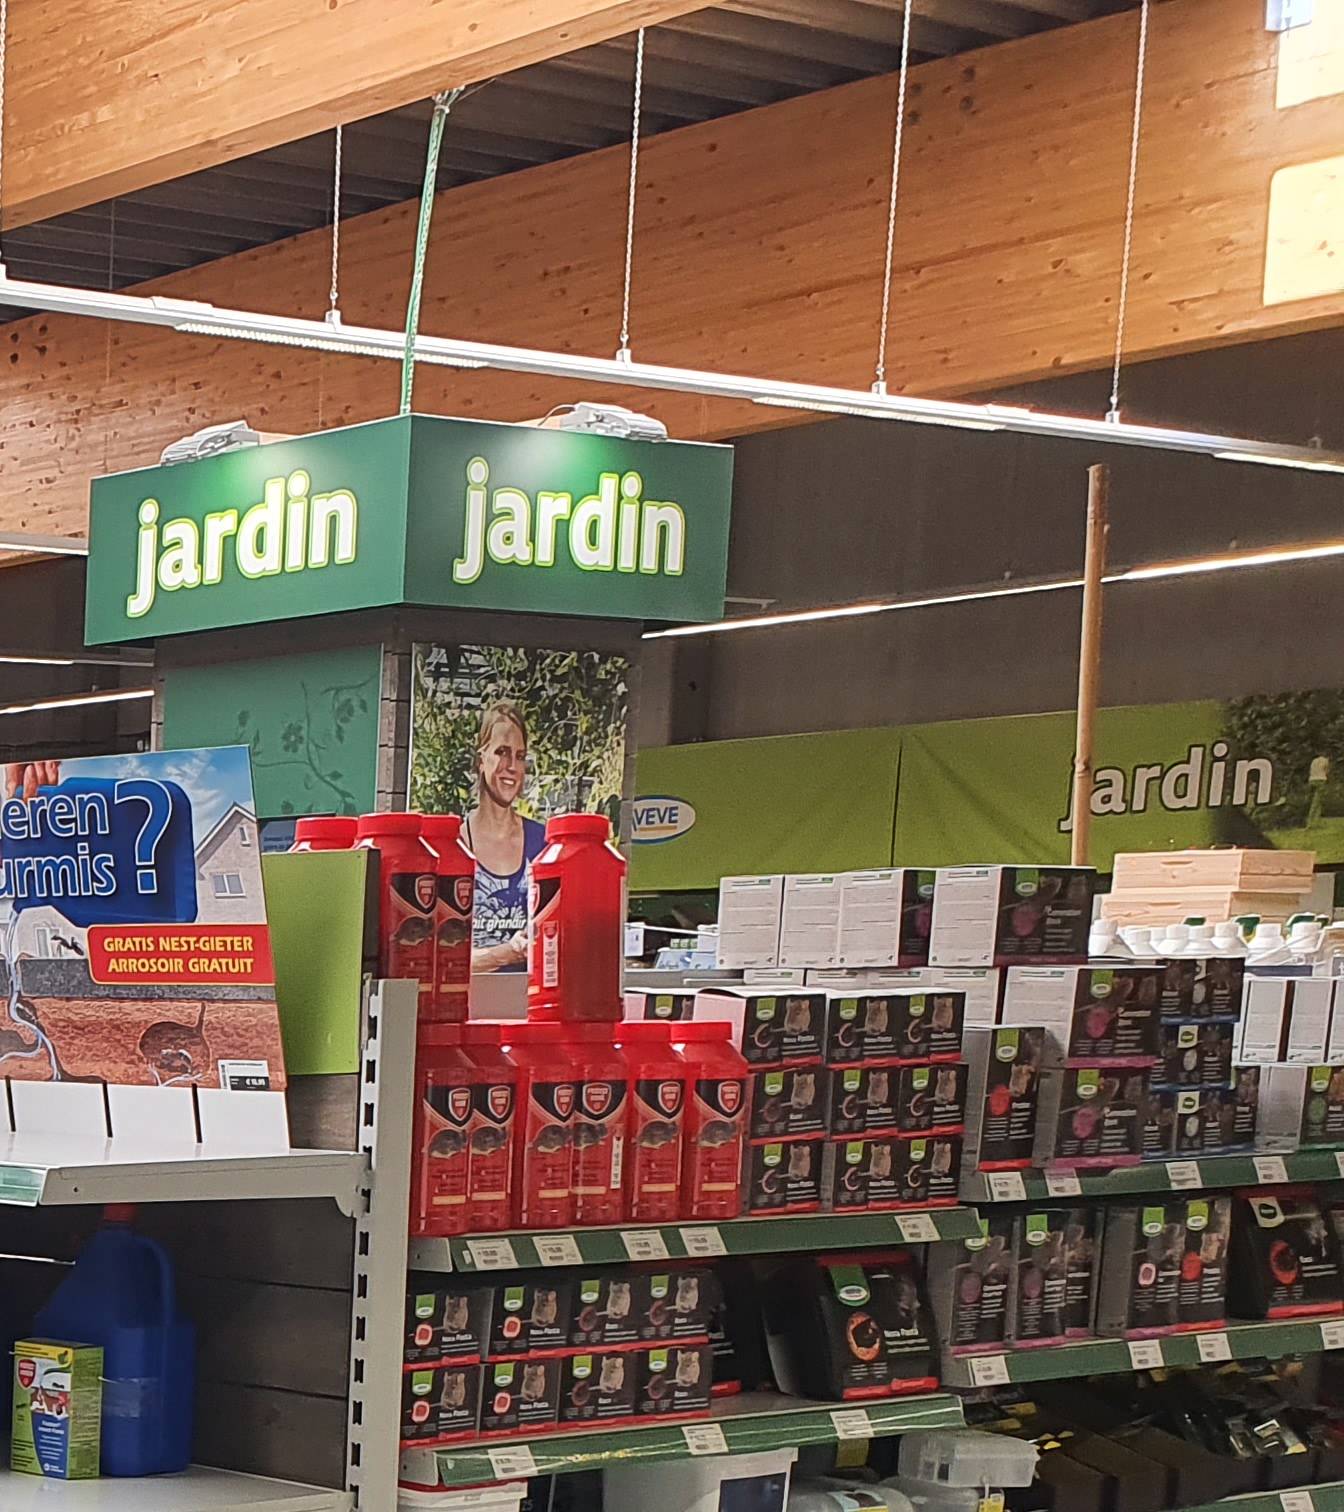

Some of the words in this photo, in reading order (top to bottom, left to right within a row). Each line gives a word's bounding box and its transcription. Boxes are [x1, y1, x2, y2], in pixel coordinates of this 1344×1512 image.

[453, 457, 685, 585] jardin
[127, 470, 358, 618] jardin
[632, 806, 679, 832] VEVE
[487, 917, 528, 932] grandir
[103, 937, 155, 952] GRATIS
[159, 936, 253, 951] NEST-GIETER
[107, 957, 184, 973] ARROSOIR
[188, 957, 254, 973] GRATUIT
